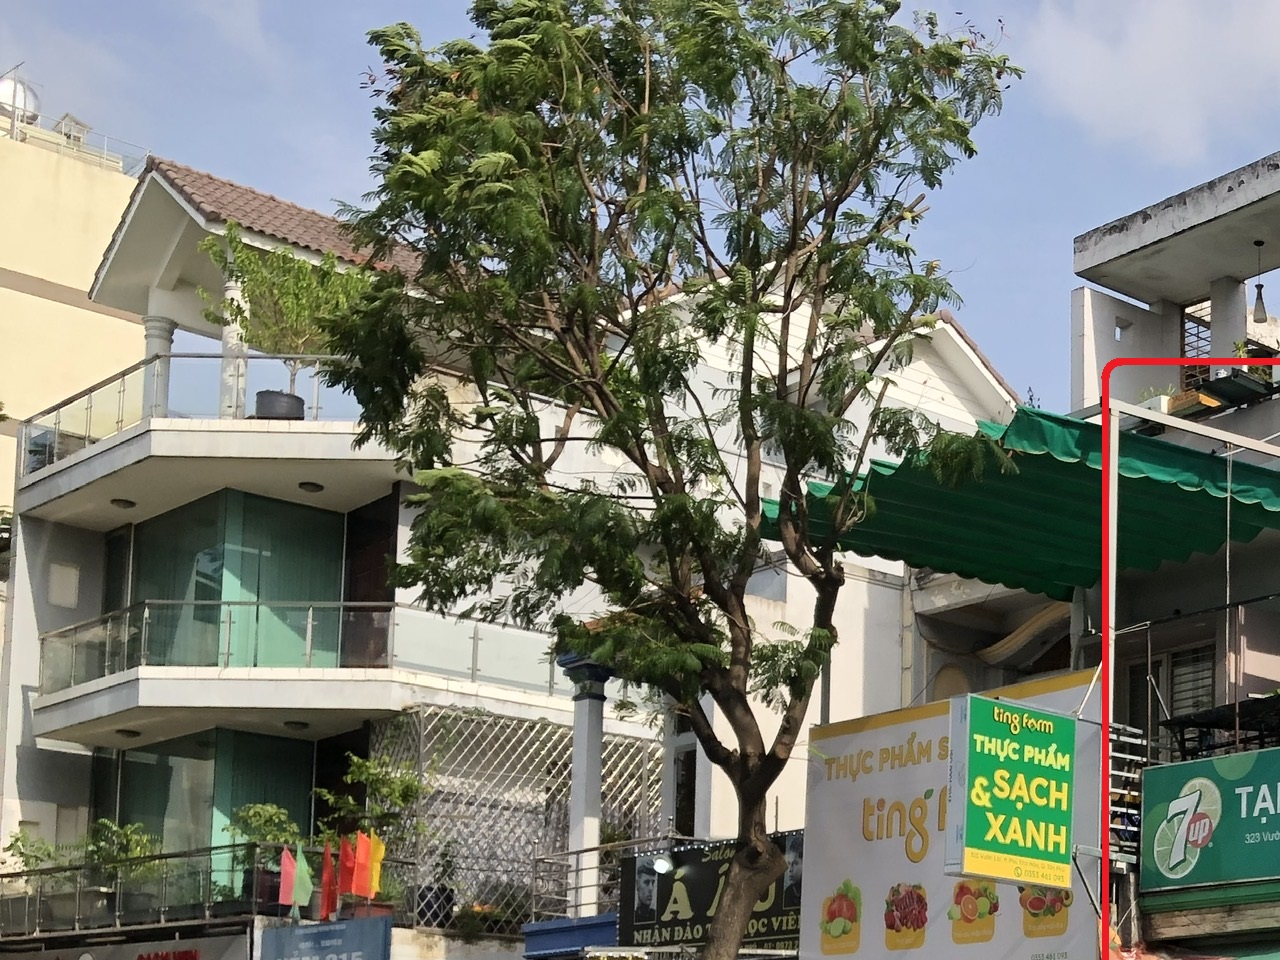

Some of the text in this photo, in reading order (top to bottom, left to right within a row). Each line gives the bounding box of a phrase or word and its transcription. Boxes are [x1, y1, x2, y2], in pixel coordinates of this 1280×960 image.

[994, 706, 1020, 734] ting
[825, 749, 874, 783] THỰC
[878, 732, 932, 771] PHẨM
[973, 734, 1020, 762] THỰC
[970, 776, 993, 808] &
[992, 769, 1069, 811] SẠCH
[862, 797, 929, 863] ting
[984, 811, 1067, 855] XANH
[1245, 833, 1261, 843] 323
[1024, 869, 1039, 879] 0353
[661, 869, 694, 922] Á
[633, 924, 673, 946] NHẬN
